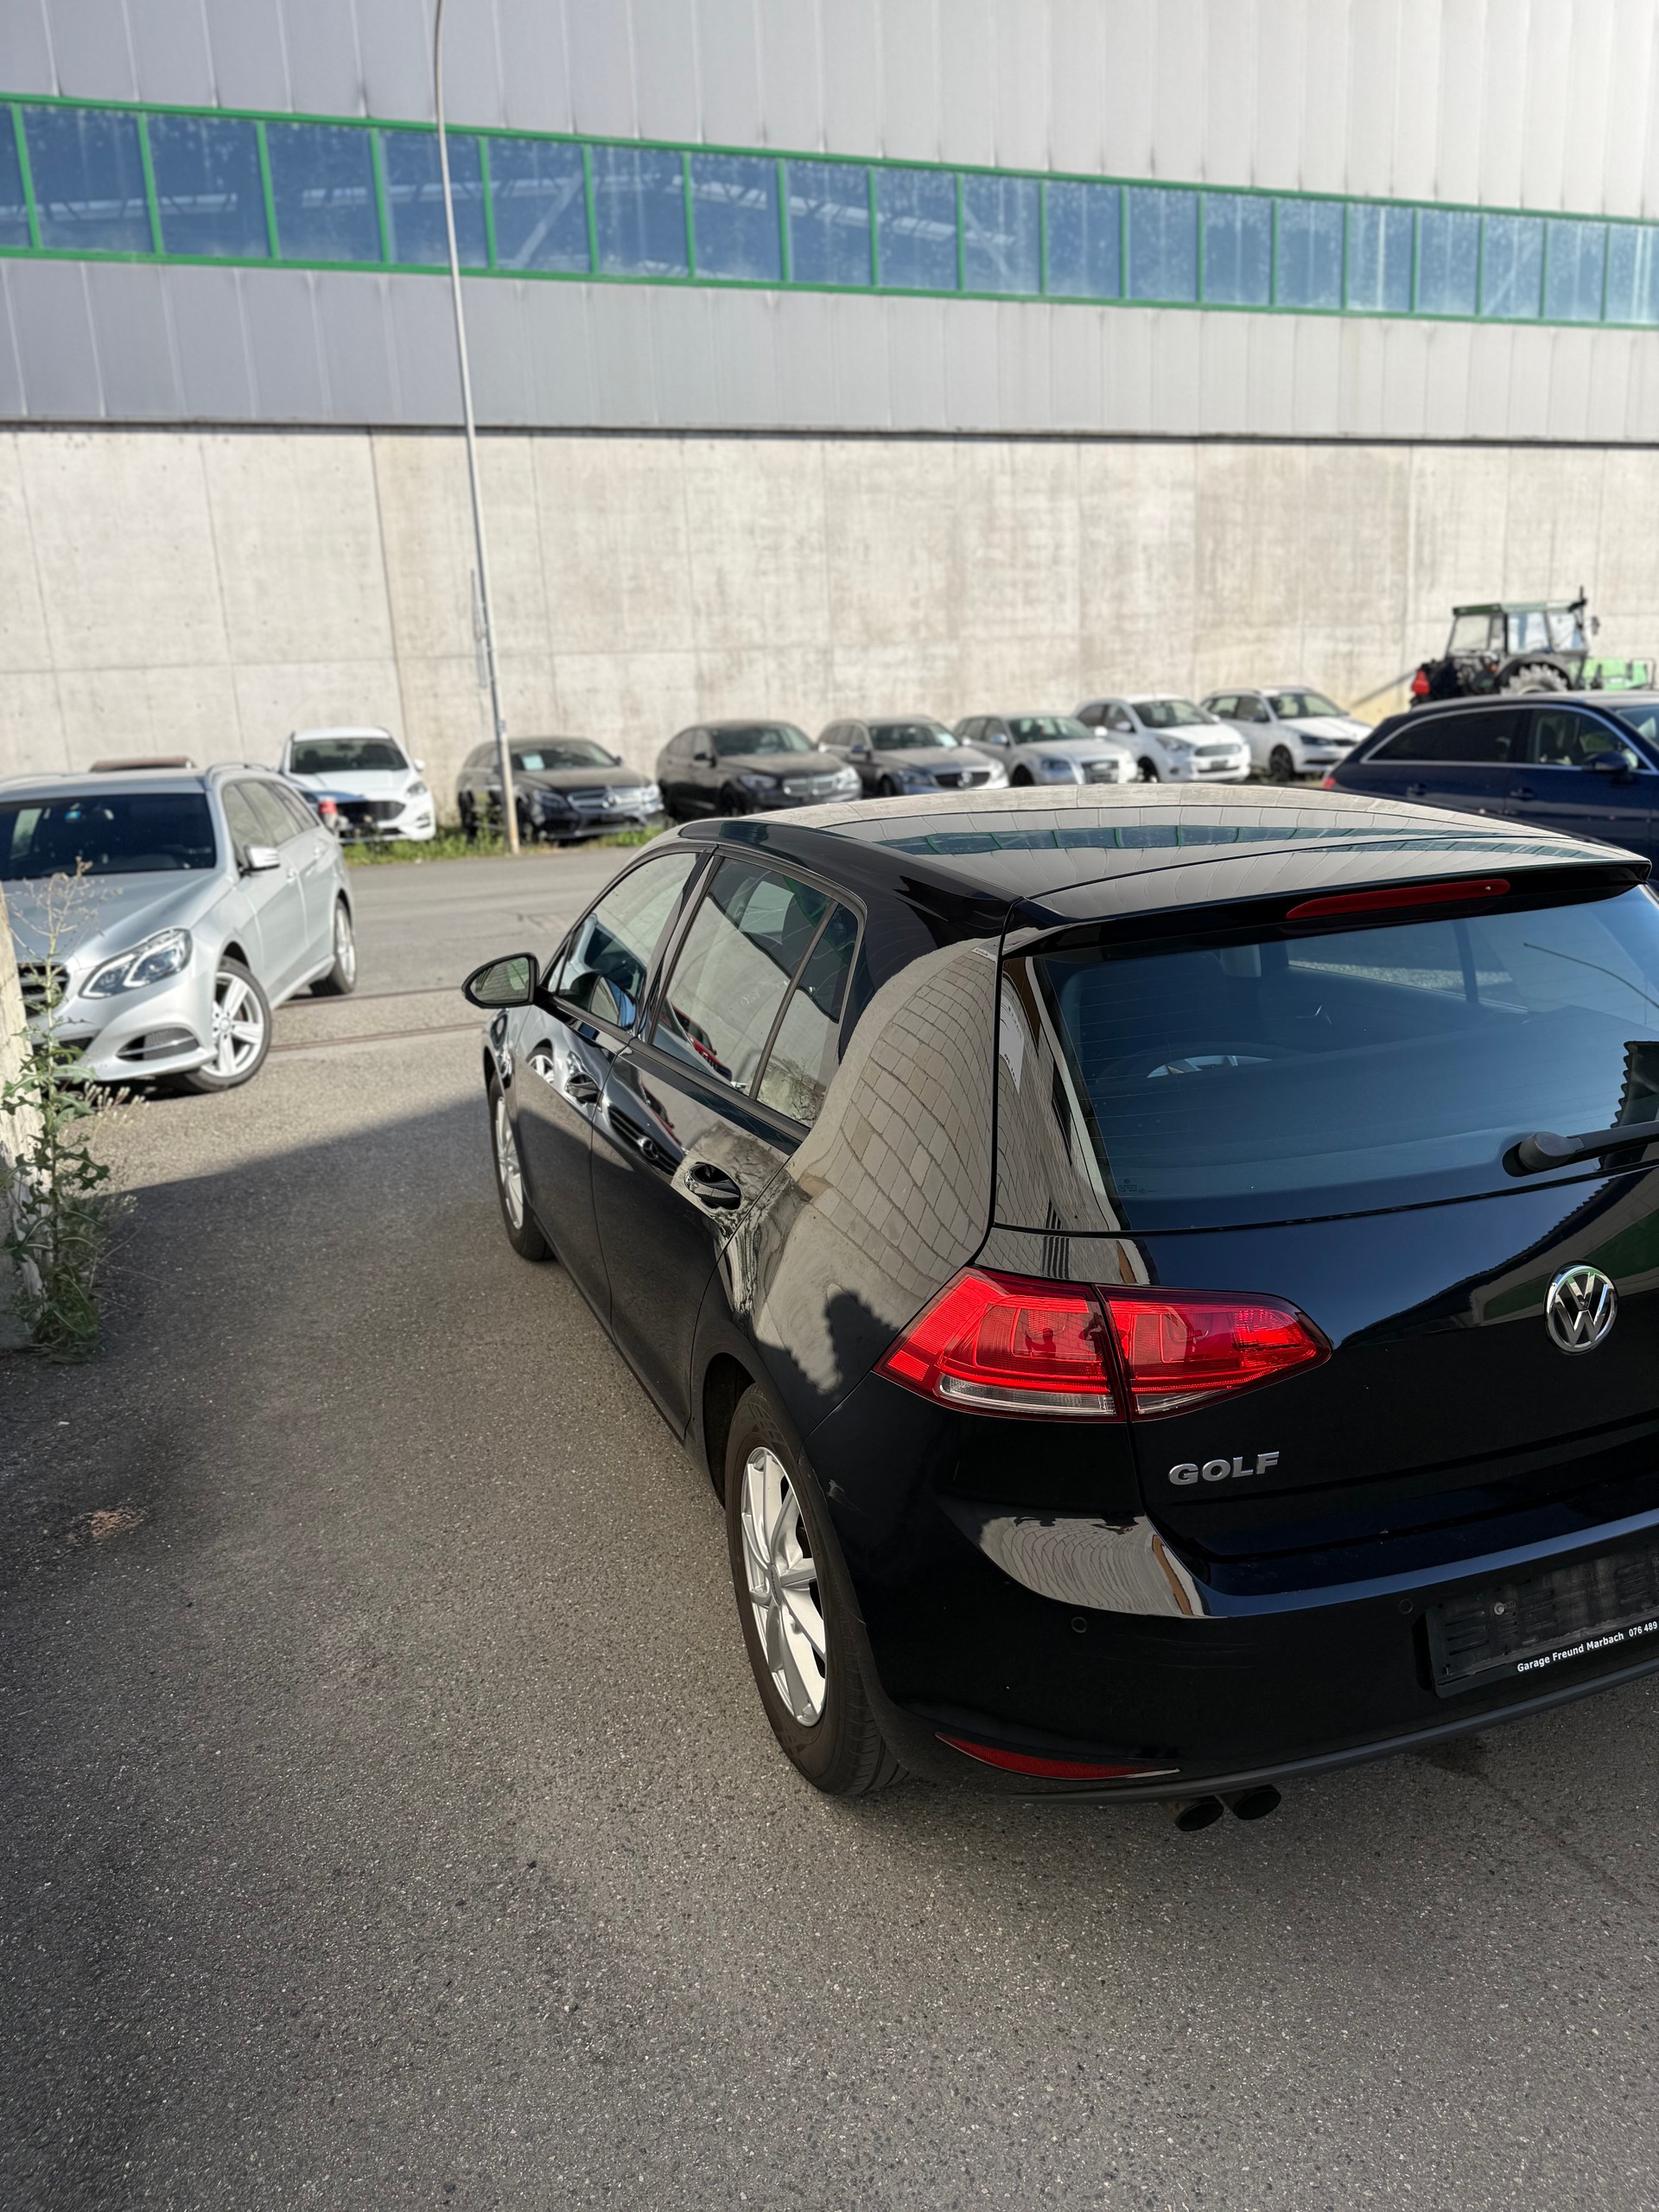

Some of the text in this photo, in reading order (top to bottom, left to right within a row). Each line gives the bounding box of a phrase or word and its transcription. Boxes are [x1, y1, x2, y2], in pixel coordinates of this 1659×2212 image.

[1168, 1451, 1280, 1485] GOLF
[1517, 1621, 1658, 1672] Garage Freund Marbach 076 489
